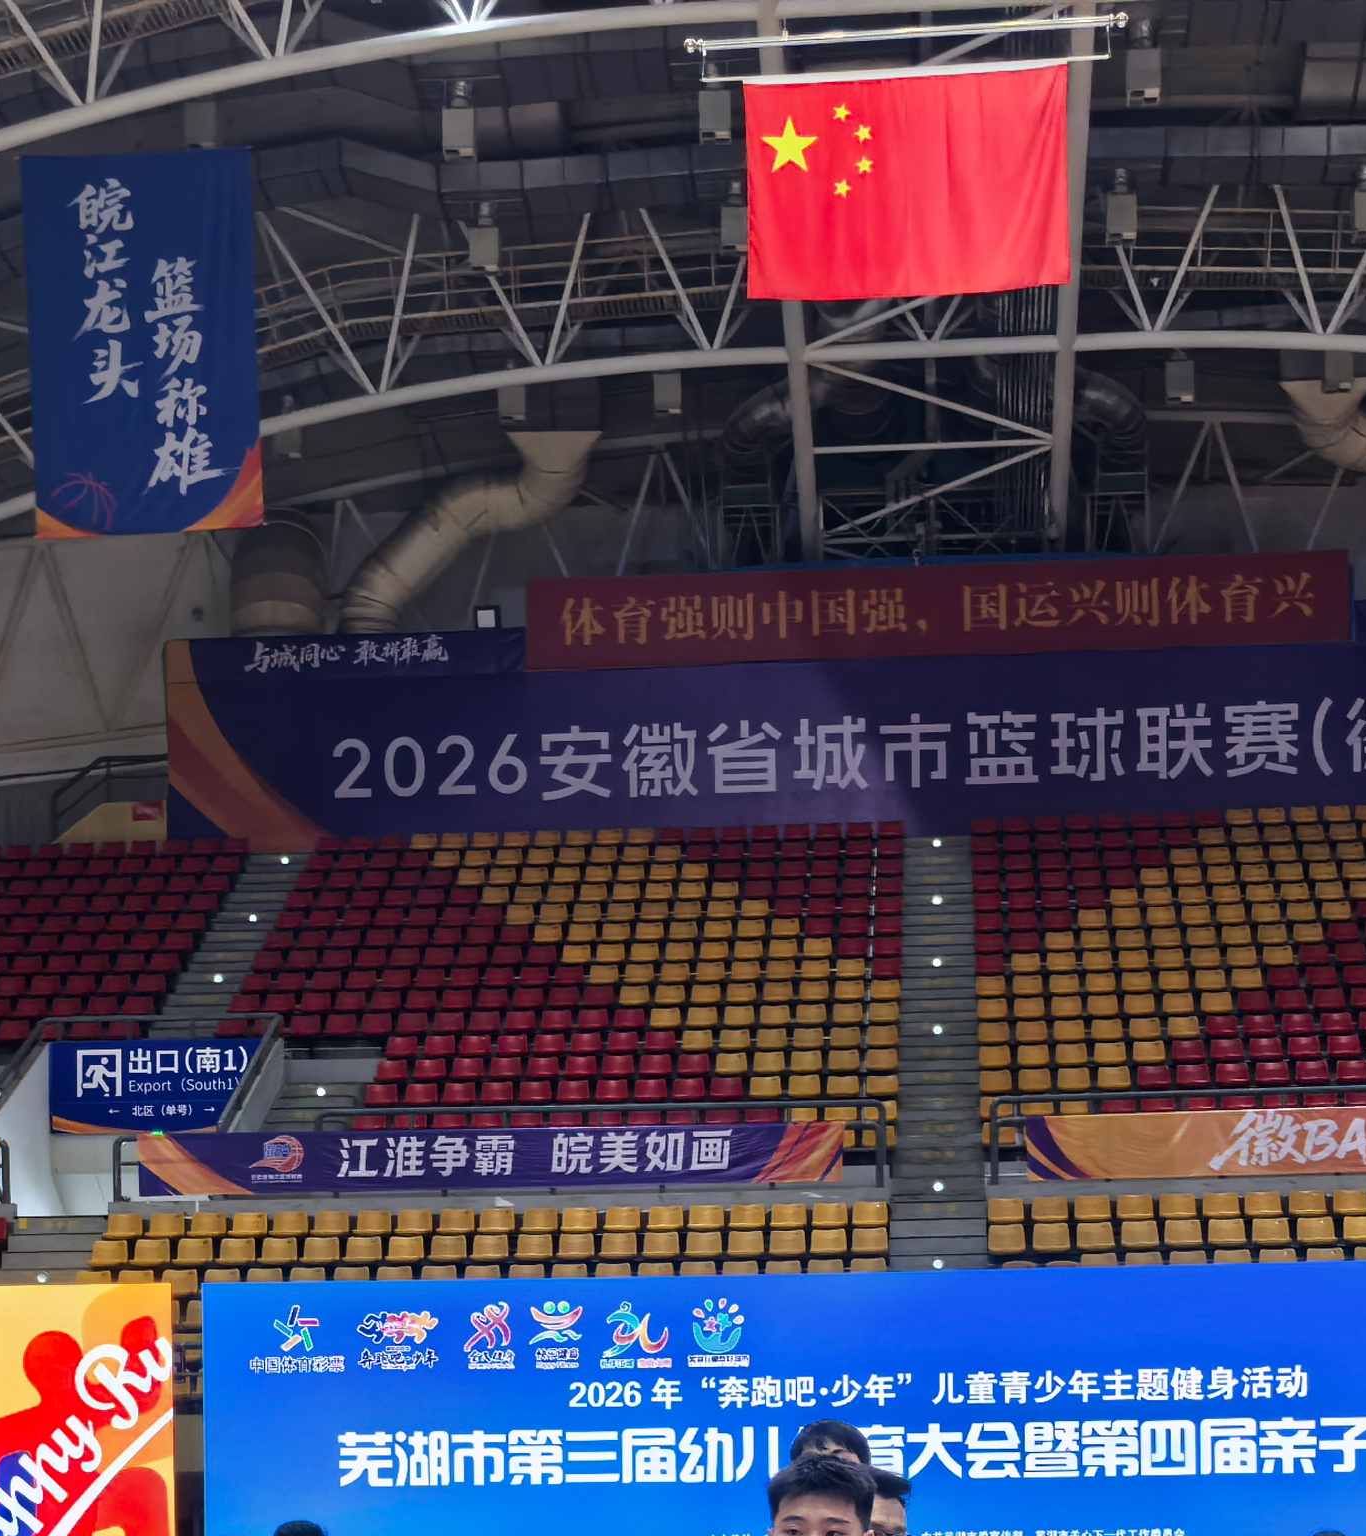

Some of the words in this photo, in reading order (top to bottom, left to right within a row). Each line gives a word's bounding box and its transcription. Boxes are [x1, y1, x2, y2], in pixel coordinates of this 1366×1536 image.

[67, 177, 144, 405] 皖江龙头
[142, 256, 225, 496] 篮场称雄
[128, 1079, 172, 1095] Export
[335, 1133, 515, 1181] 江淮争霸
[550, 1126, 734, 1177] 皖美如画
